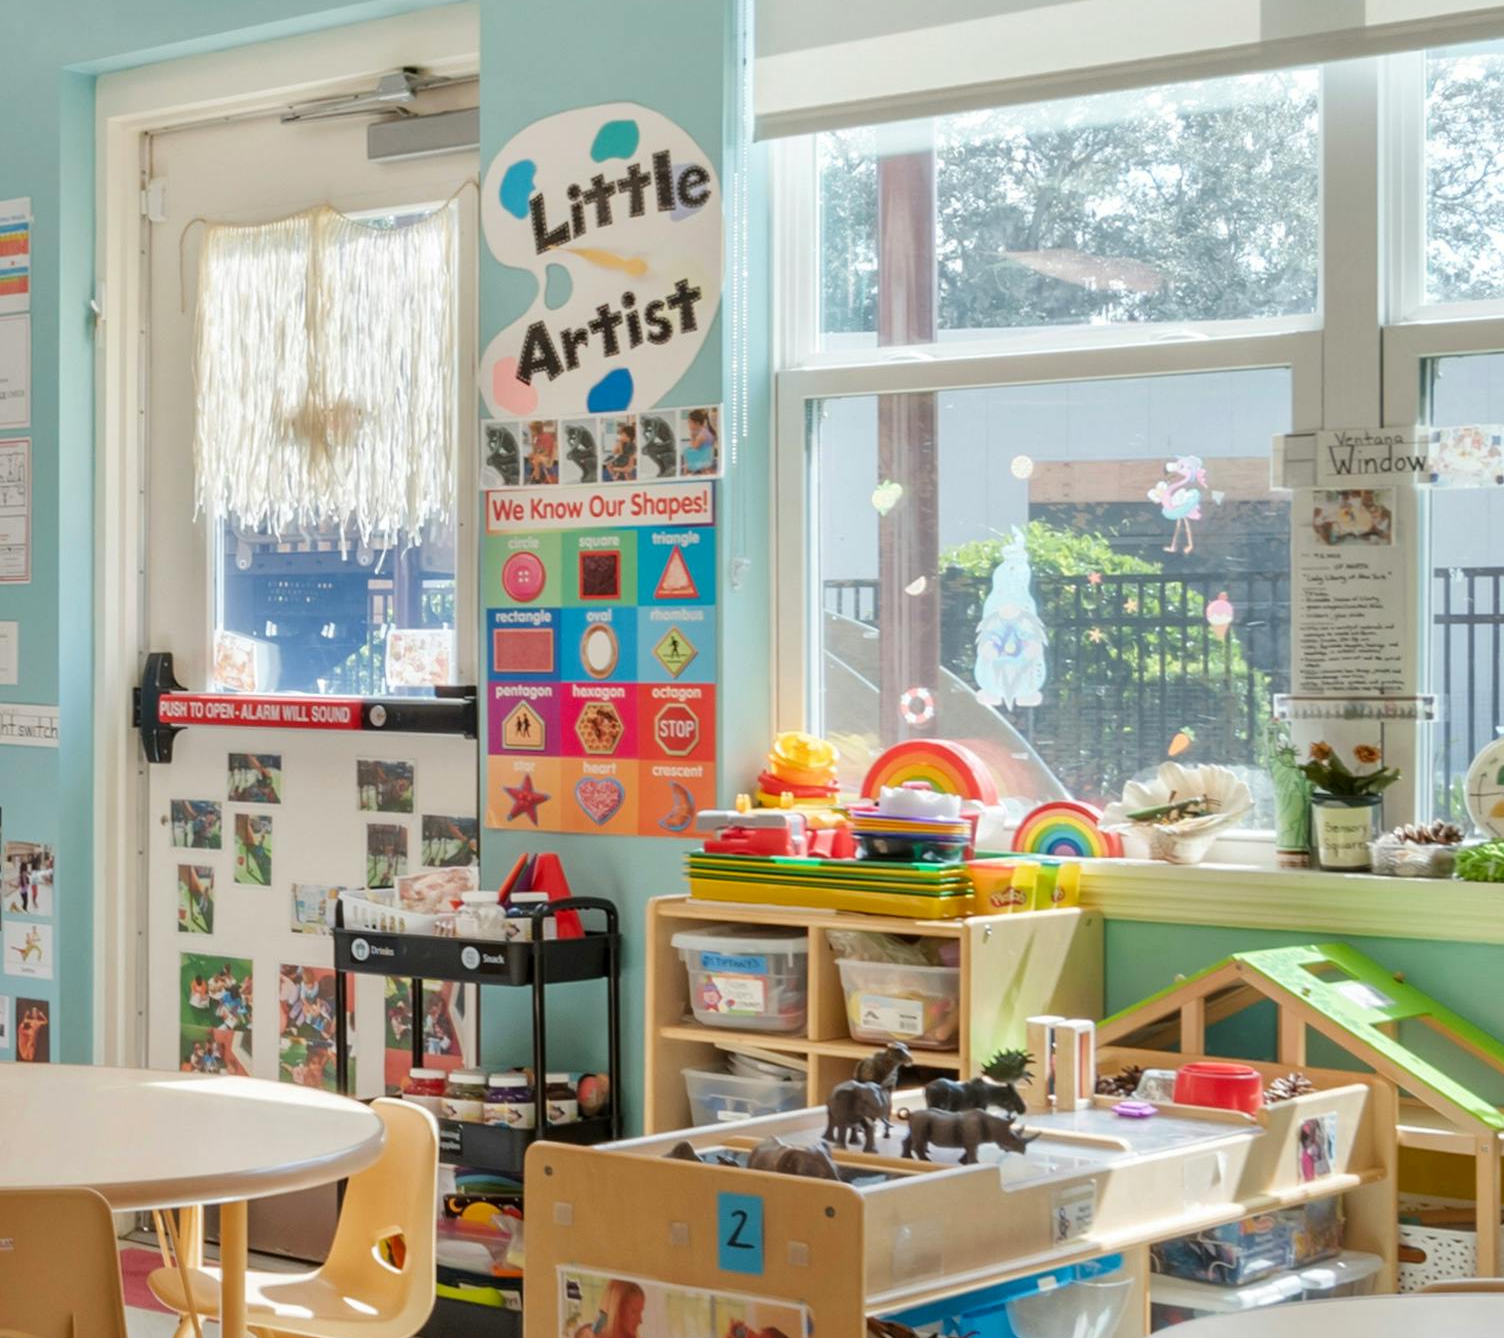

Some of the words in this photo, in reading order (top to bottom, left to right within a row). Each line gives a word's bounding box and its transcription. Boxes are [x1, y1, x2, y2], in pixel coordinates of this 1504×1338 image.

[529, 149, 711, 255] Little
[515, 278, 702, 387] Artist
[1334, 433, 1404, 447] Ventana
[1328, 444, 1427, 475] Window
[493, 499, 525, 521] We
[530, 497, 583, 521] Know
[589, 495, 625, 518] Our
[631, 490, 708, 521] Shapes!
[508, 537, 539, 550] circle
[578, 535, 620, 549] square
[652, 531, 700, 547] triangle
[496, 610, 552, 624] rectangle
[586, 610, 612, 623] oval
[650, 609, 704, 621] rhombus
[496, 686, 552, 701] pentagon
[572, 685, 625, 701] hexagon
[652, 686, 701, 701] octagon
[159, 701, 187, 717] PUSH
[189, 702, 204, 717] TO
[206, 703, 234, 718] OPEN
[241, 704, 280, 721] ALARM
[282, 706, 309, 722] WILL
[311, 707, 350, 723] SOUND
[19, 716, 58, 738] switch
[660, 721, 695, 738] STOP
[512, 761, 535, 772] star
[582, 762, 617, 774] heart
[652, 766, 704, 778] crescent
[1324, 821, 1368, 839] Sensory
[370, 945, 394, 957] Drinks
[482, 953, 505, 964] Snack
[726, 1209, 756, 1249] 2
